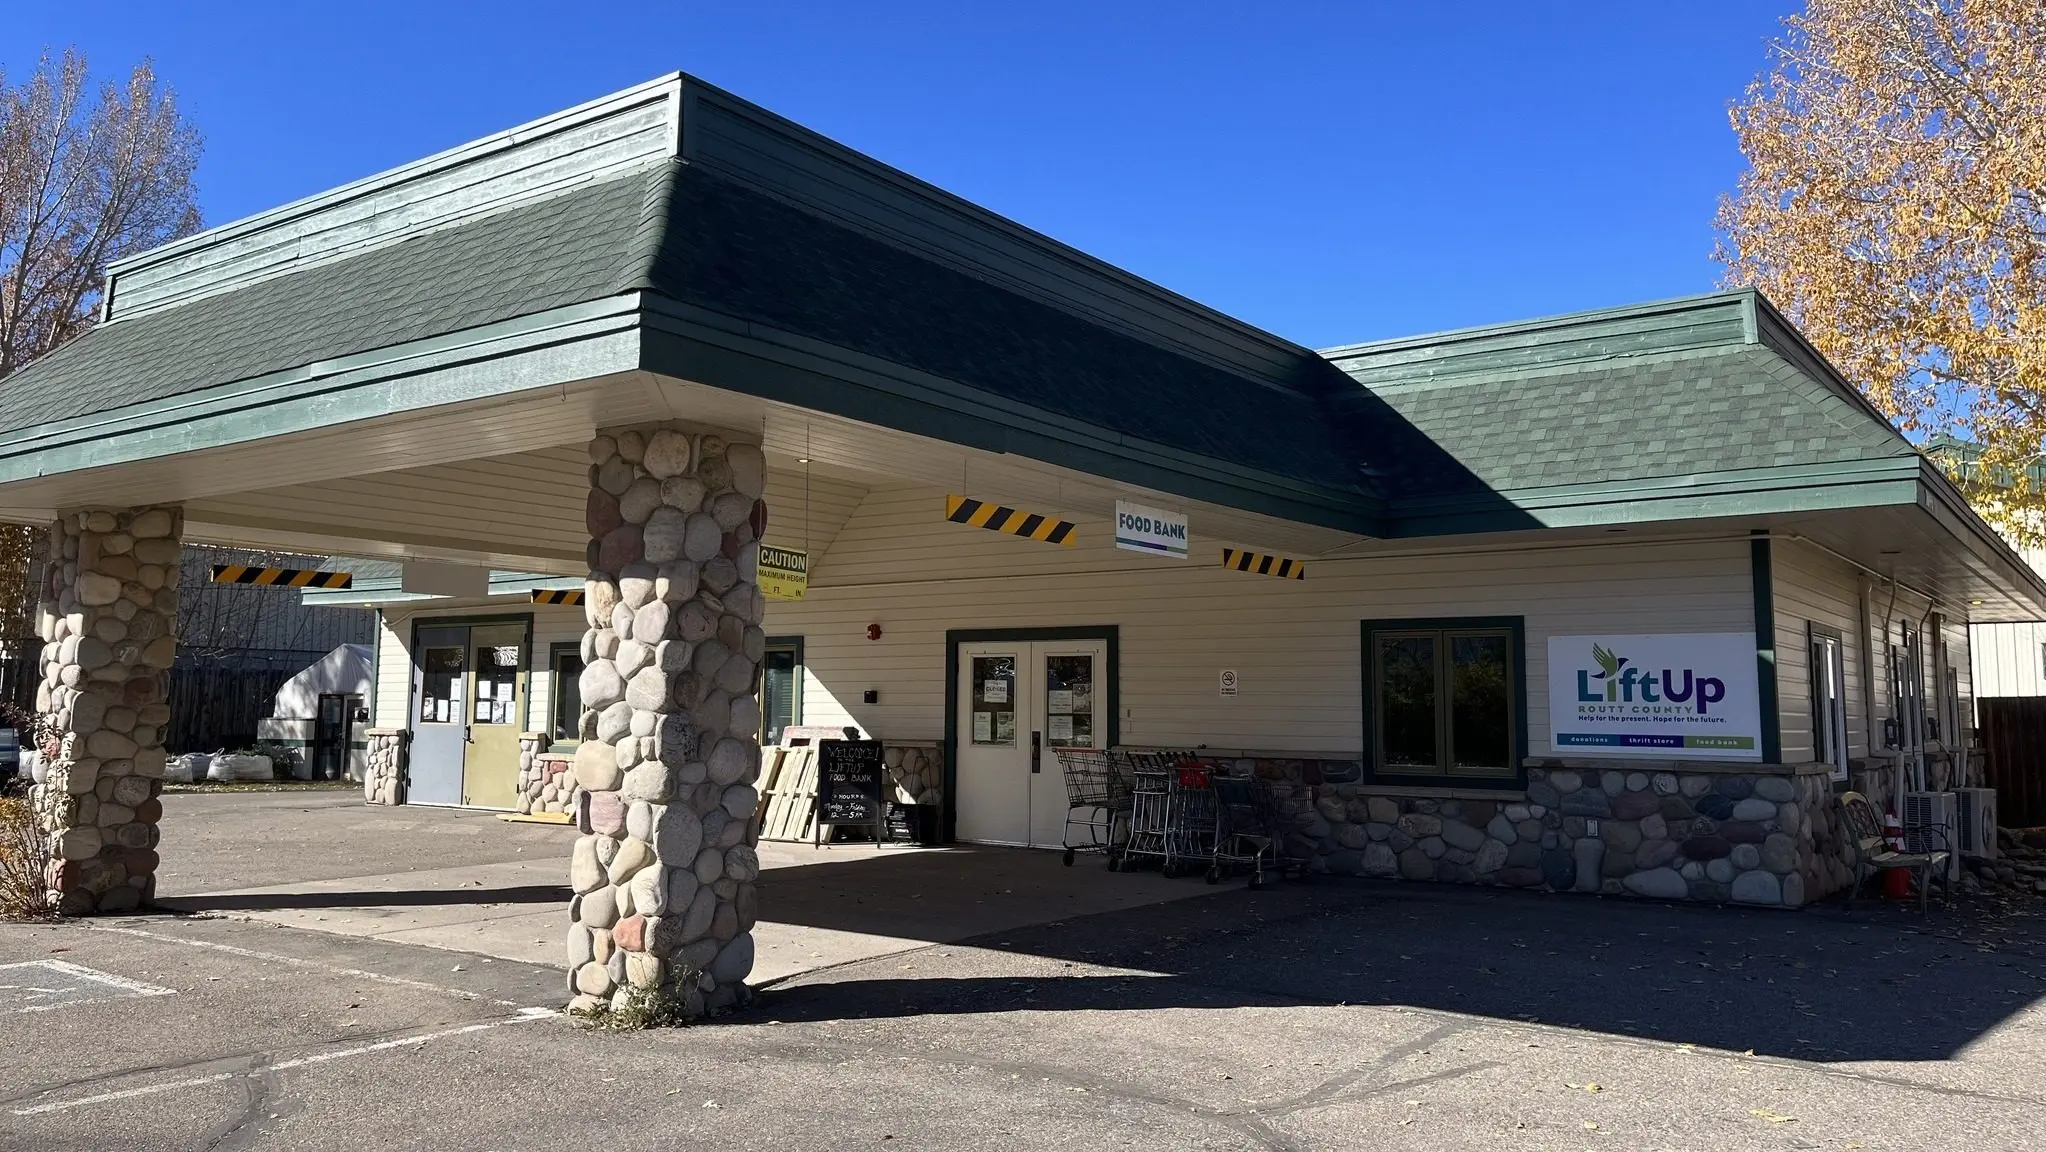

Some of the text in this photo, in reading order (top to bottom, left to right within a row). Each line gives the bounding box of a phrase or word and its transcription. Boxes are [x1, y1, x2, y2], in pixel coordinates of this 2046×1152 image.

[1120, 512, 1185, 540] FOOD BANK
[760, 549, 806, 570] CAUTION
[759, 570, 806, 584] MAXIMUM HEIGHT
[1577, 667, 1726, 714] LiftUp
[1578, 705, 1693, 714] ROUTT COUNTY
[1621, 715, 1652, 723] present.
